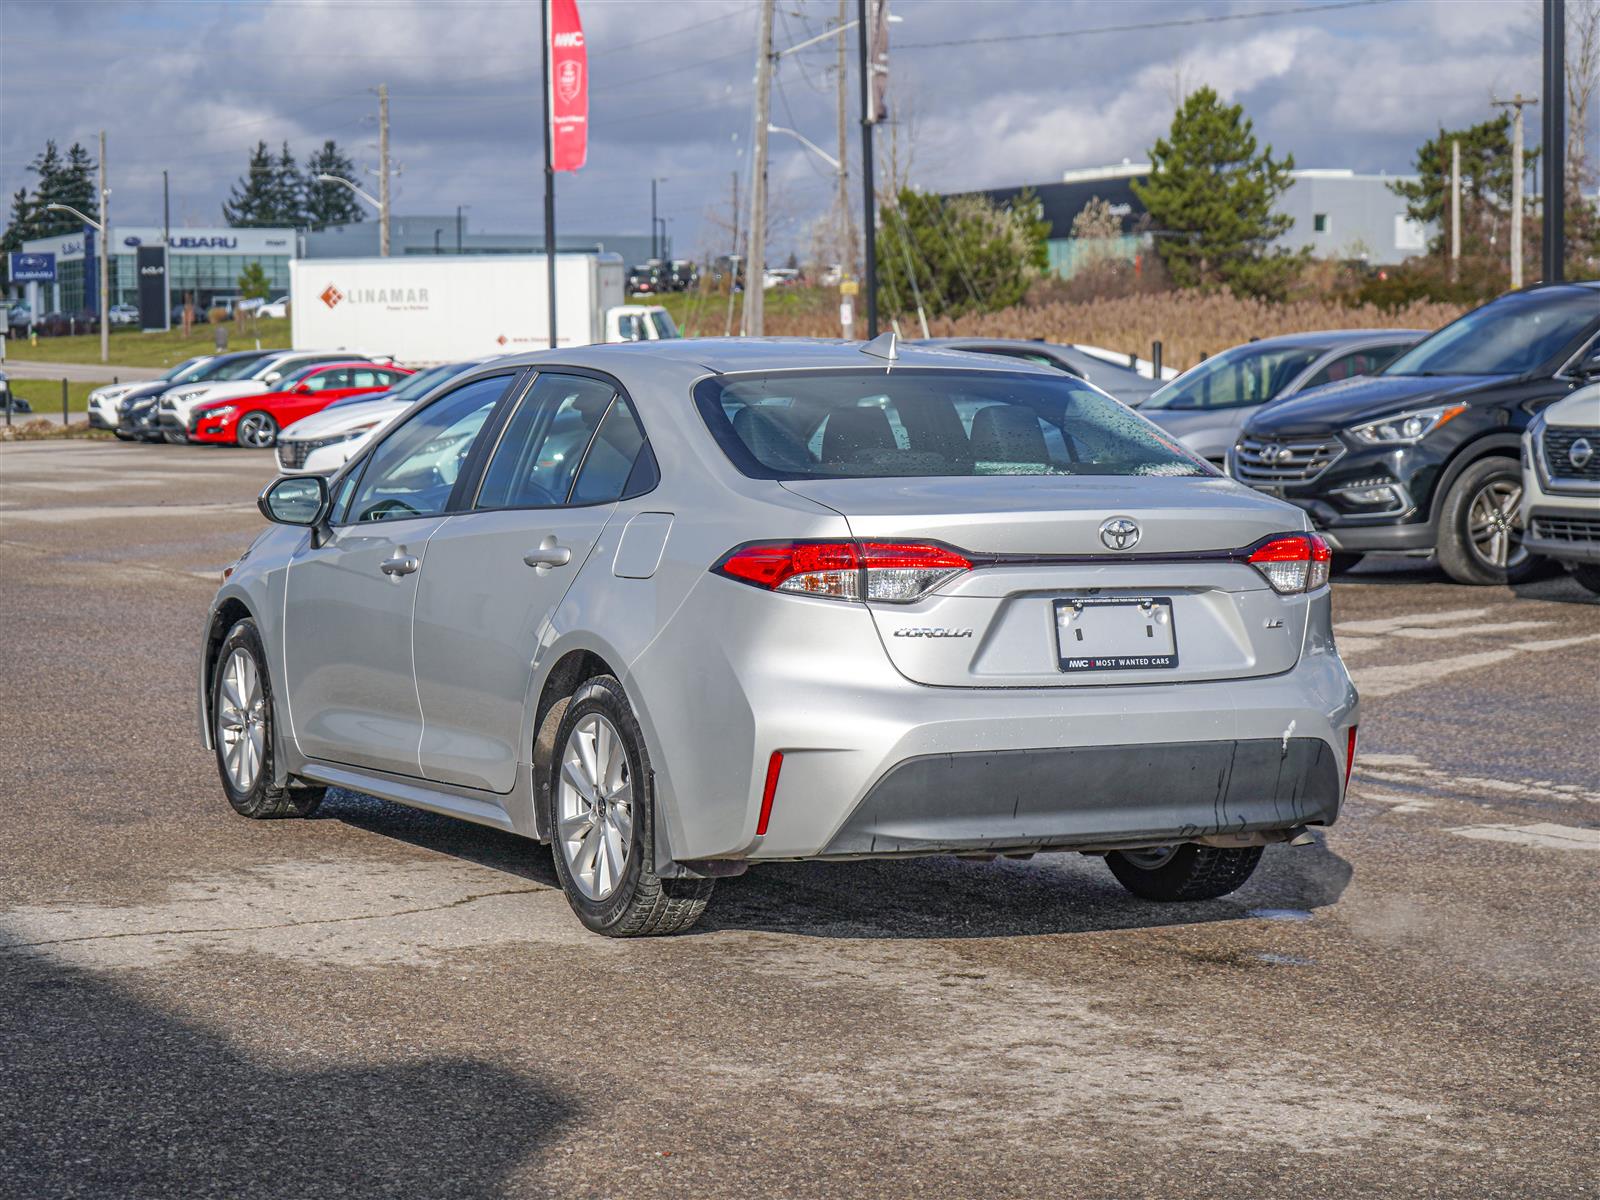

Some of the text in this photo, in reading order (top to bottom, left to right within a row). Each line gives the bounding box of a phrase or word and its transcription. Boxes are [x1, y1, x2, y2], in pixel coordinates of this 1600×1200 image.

[347, 288, 429, 304] LINAMAR
[893, 628, 973, 639] COROLLA
[1096, 659, 1116, 667] MOST
[1119, 658, 1149, 666] WANTED
[1151, 657, 1170, 665] CARS
